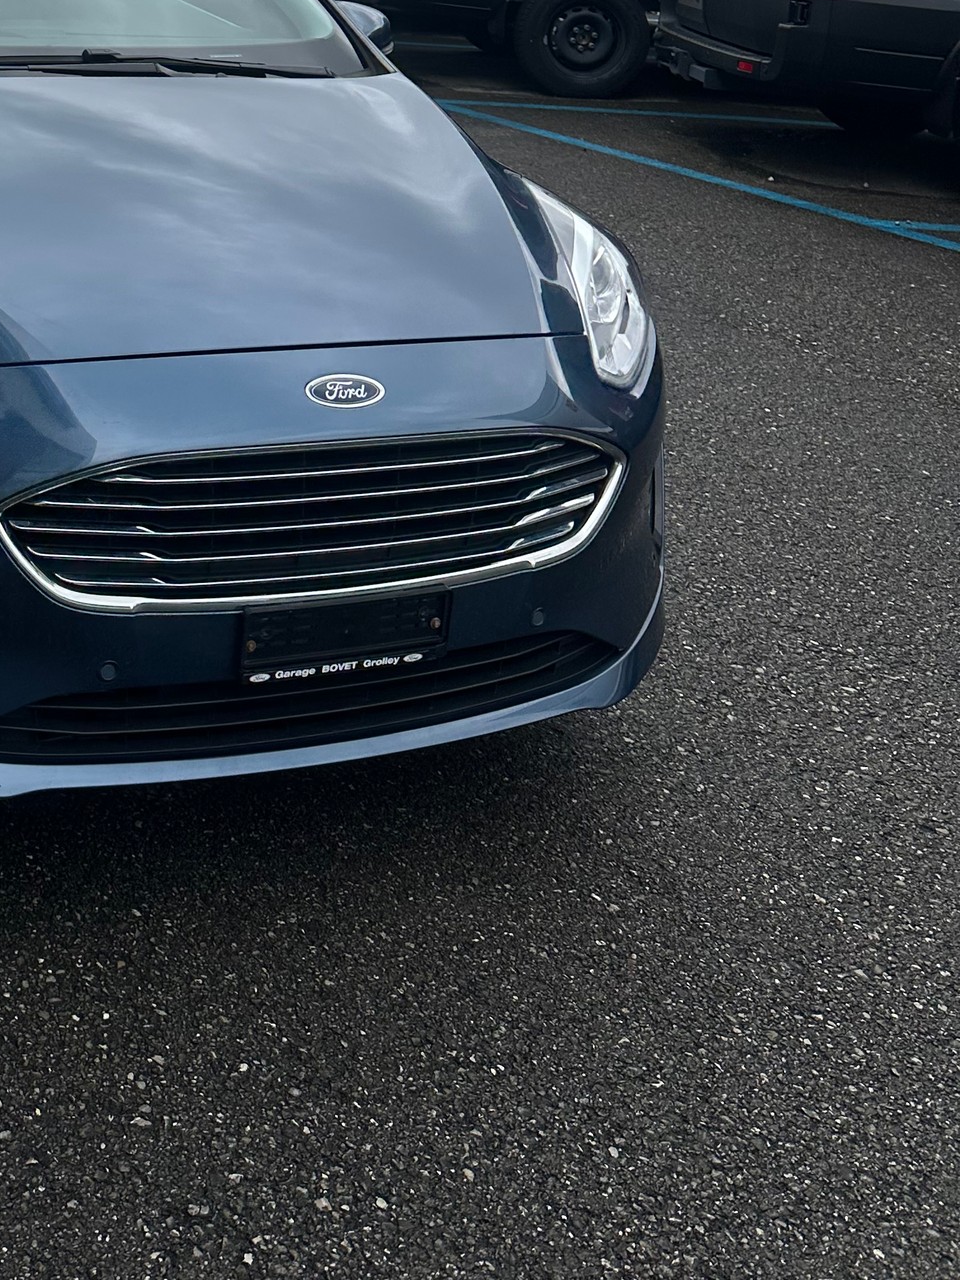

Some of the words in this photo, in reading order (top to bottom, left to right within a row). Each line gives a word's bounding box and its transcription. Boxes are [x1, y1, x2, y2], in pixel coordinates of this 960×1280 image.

[325, 381, 367, 400] Ford
[275, 668, 316, 679] Garage
[321, 661, 358, 673] BOVET
[363, 656, 400, 668] Grolley
